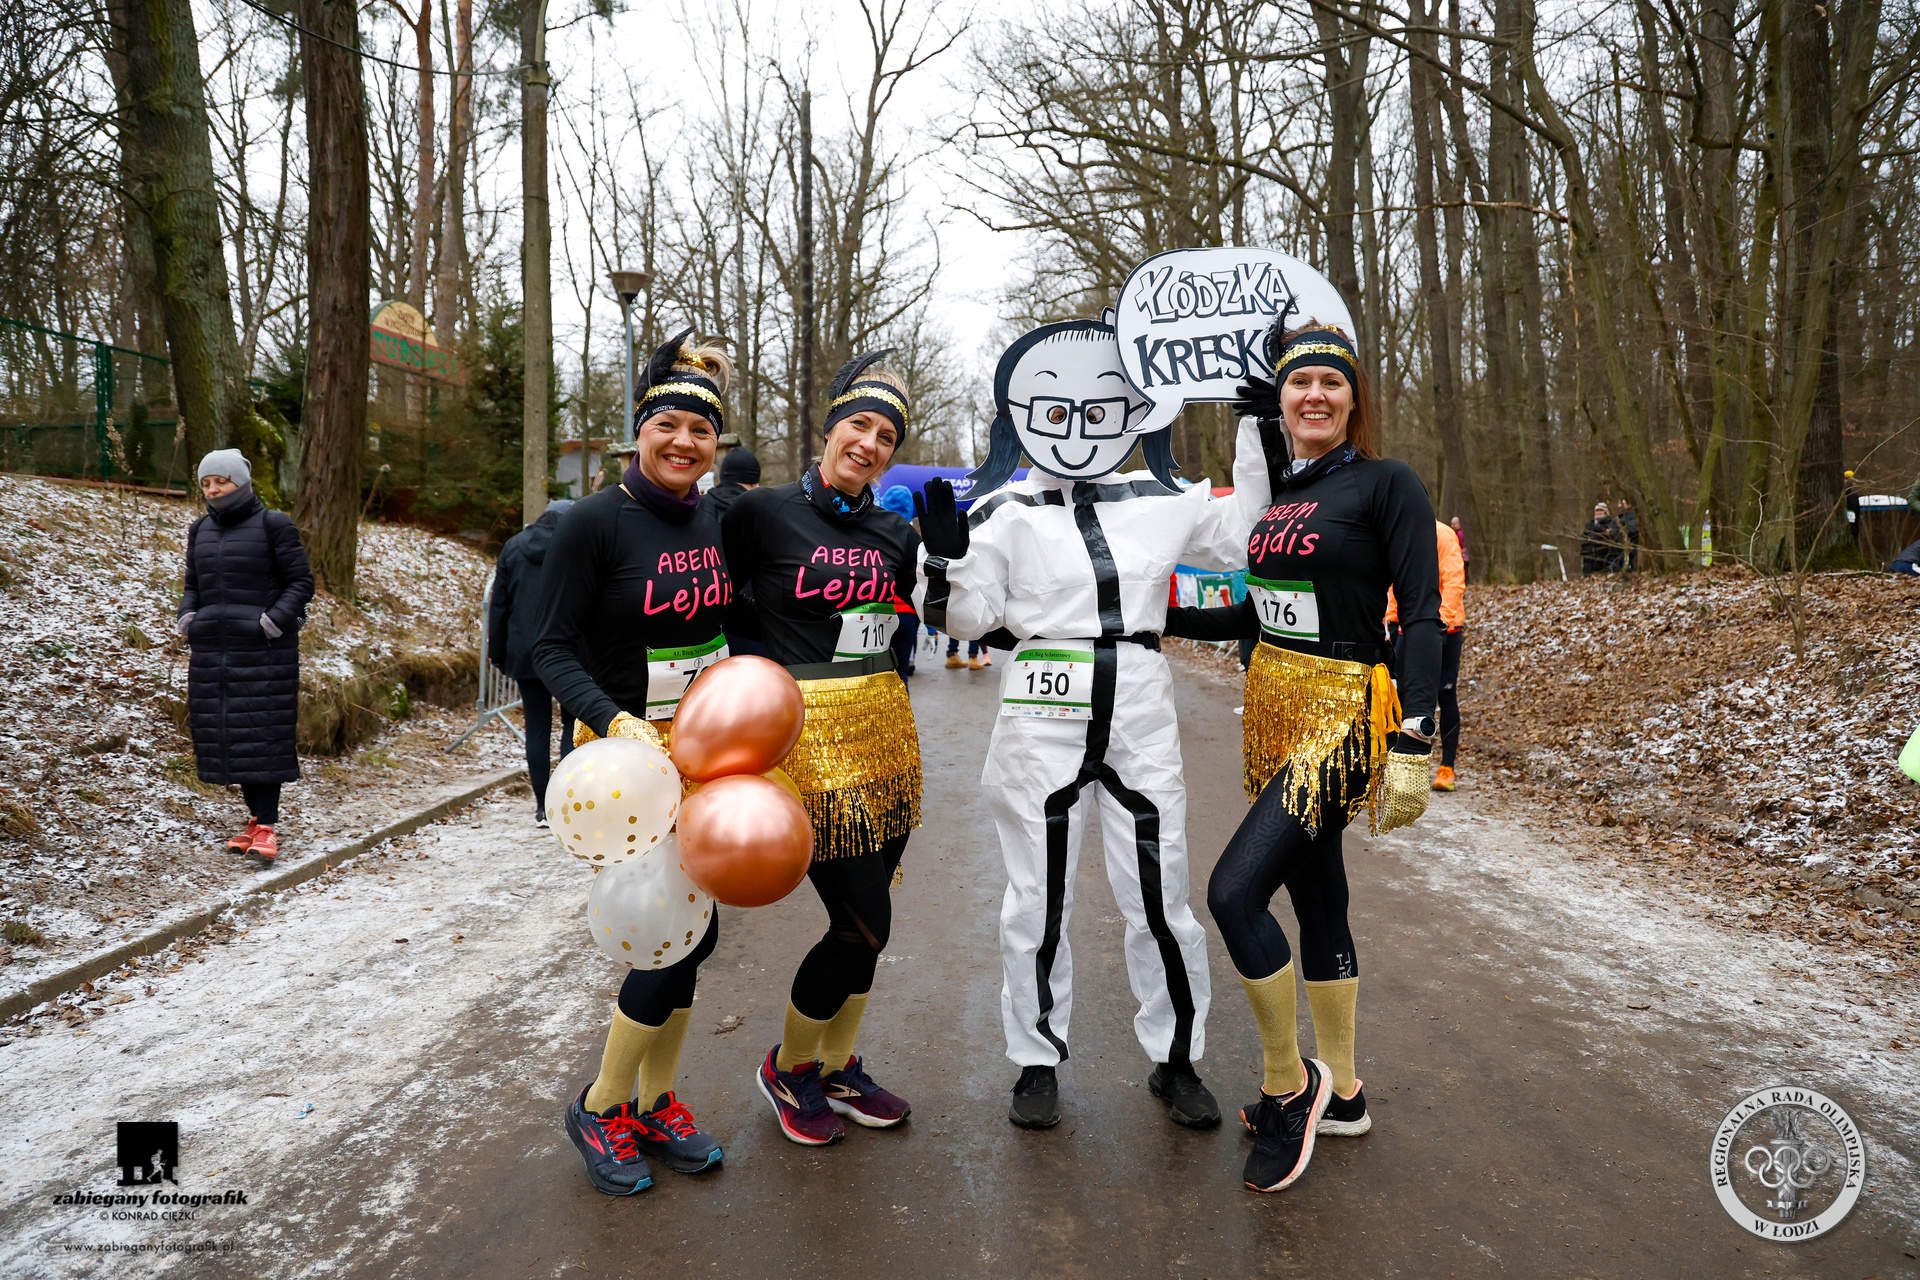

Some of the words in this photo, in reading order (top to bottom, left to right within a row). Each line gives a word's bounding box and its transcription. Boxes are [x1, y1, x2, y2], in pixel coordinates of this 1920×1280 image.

[1135, 263, 1300, 324] ŁÓDZKA
[1258, 501, 1319, 522] ABEM
[1248, 519, 1320, 563] ejdis
[657, 545, 722, 574] ABEM
[811, 546, 884, 567] ABEM
[1262, 599, 1297, 626] 176
[862, 623, 884, 649] 110
[683, 666, 709, 693] 7
[1026, 671, 1069, 696] 150
